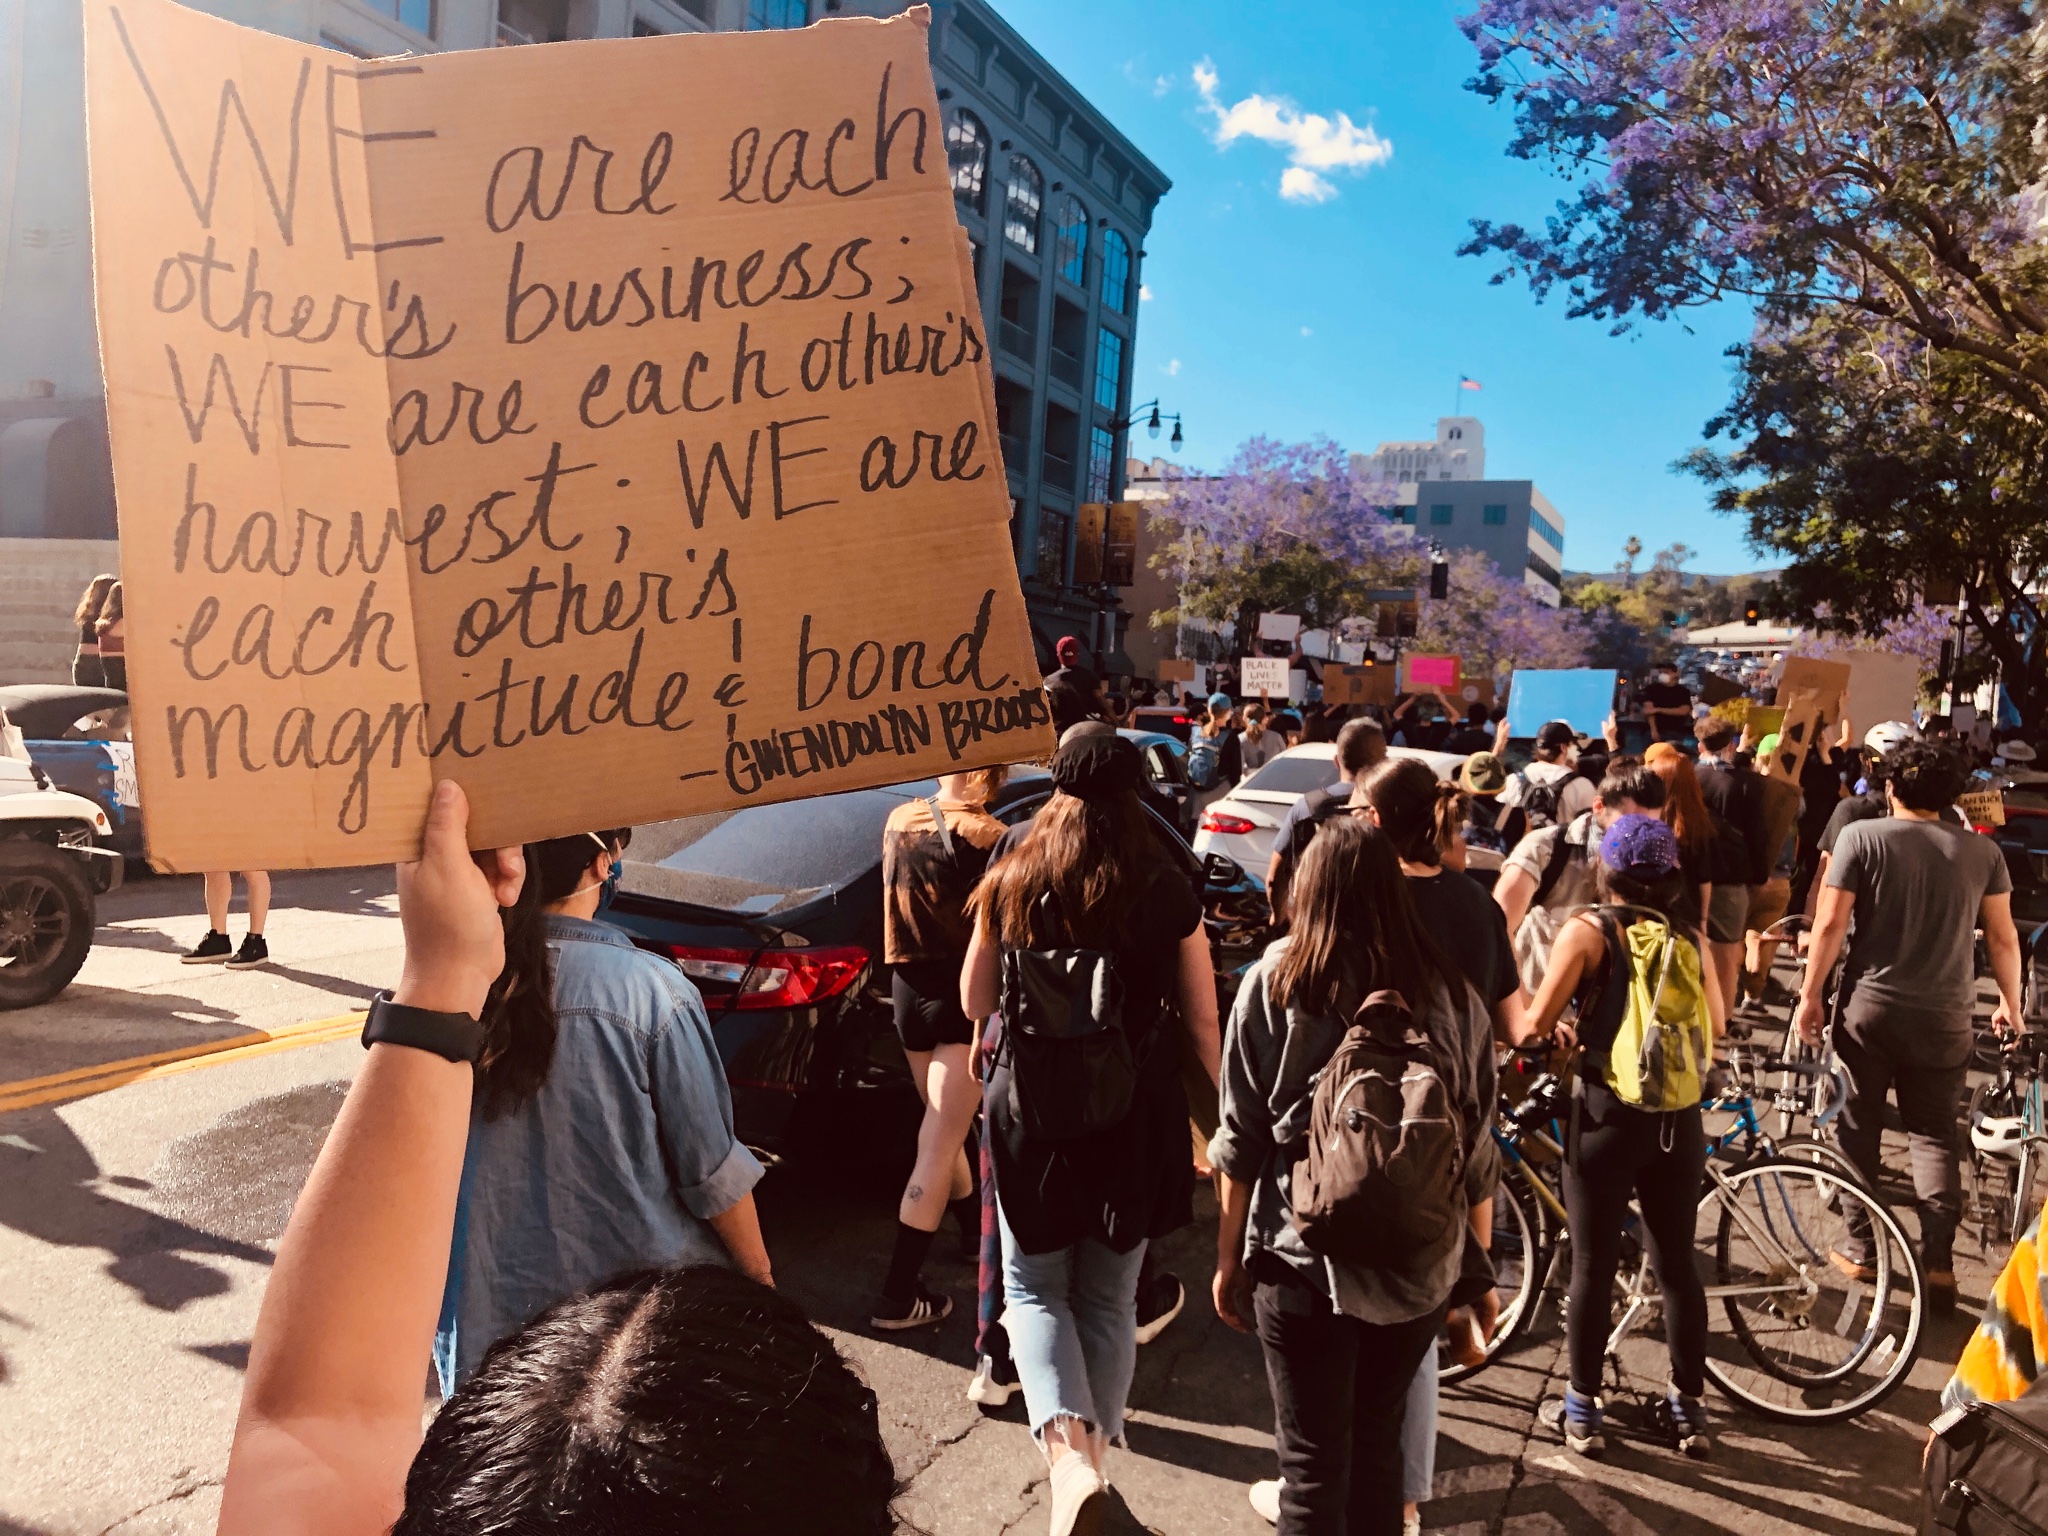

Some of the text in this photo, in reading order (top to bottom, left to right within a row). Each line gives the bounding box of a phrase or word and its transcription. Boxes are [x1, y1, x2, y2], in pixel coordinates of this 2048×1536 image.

[110, 5, 927, 260] WE are each
[153, 235, 915, 360] other's business;
[164, 311, 984, 457] WE are each other's
[677, 415, 840, 530] WE
[859, 420, 987, 493] are
[170, 547, 738, 681] each other's
[1245, 660, 1278, 670] BLACK
[1249, 671, 1278, 680] LIVES
[166, 626, 694, 835] magnitude
[797, 588, 1021, 712] bond.
[1246, 680, 1283, 691] MATTER
